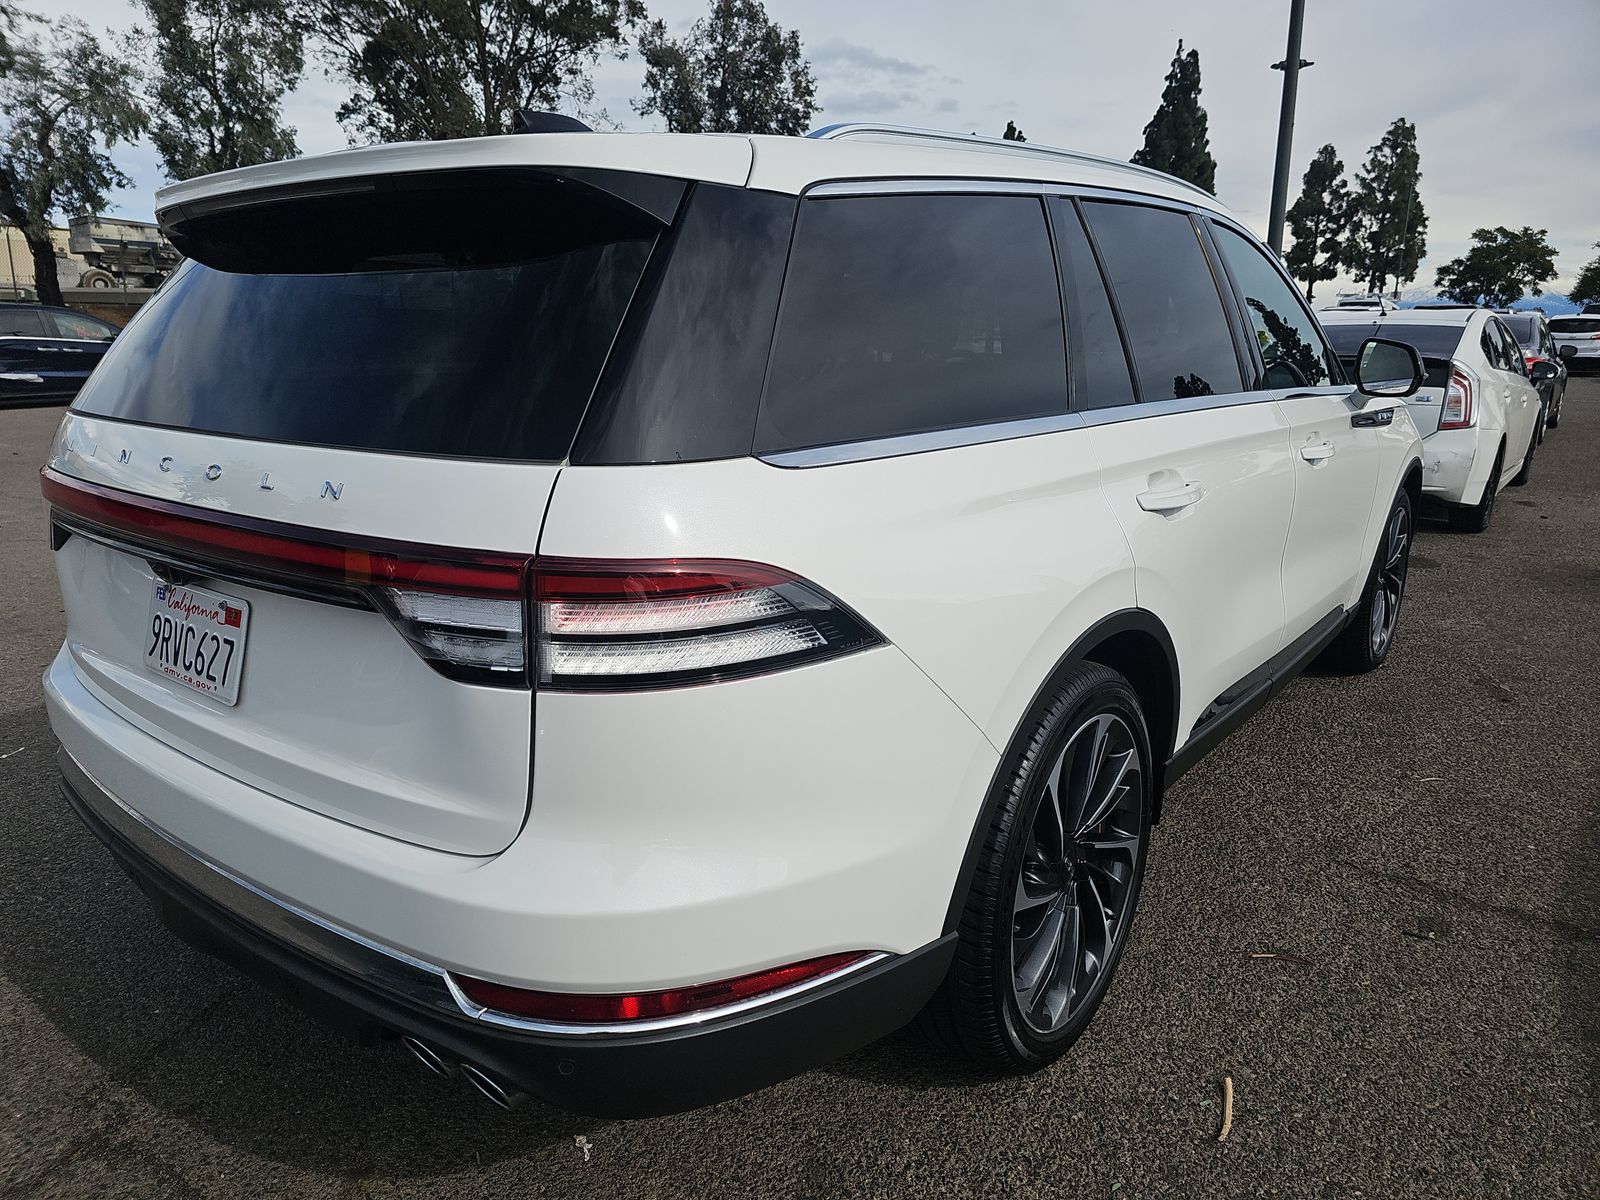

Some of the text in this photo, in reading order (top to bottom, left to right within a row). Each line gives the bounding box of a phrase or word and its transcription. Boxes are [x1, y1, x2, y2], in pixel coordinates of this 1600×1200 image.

[67, 439, 345, 501] LINCOLN
[167, 587, 225, 625] California
[148, 614, 235, 687] 9RVC627
[163, 666, 212, 691] dmv.ca.gov
